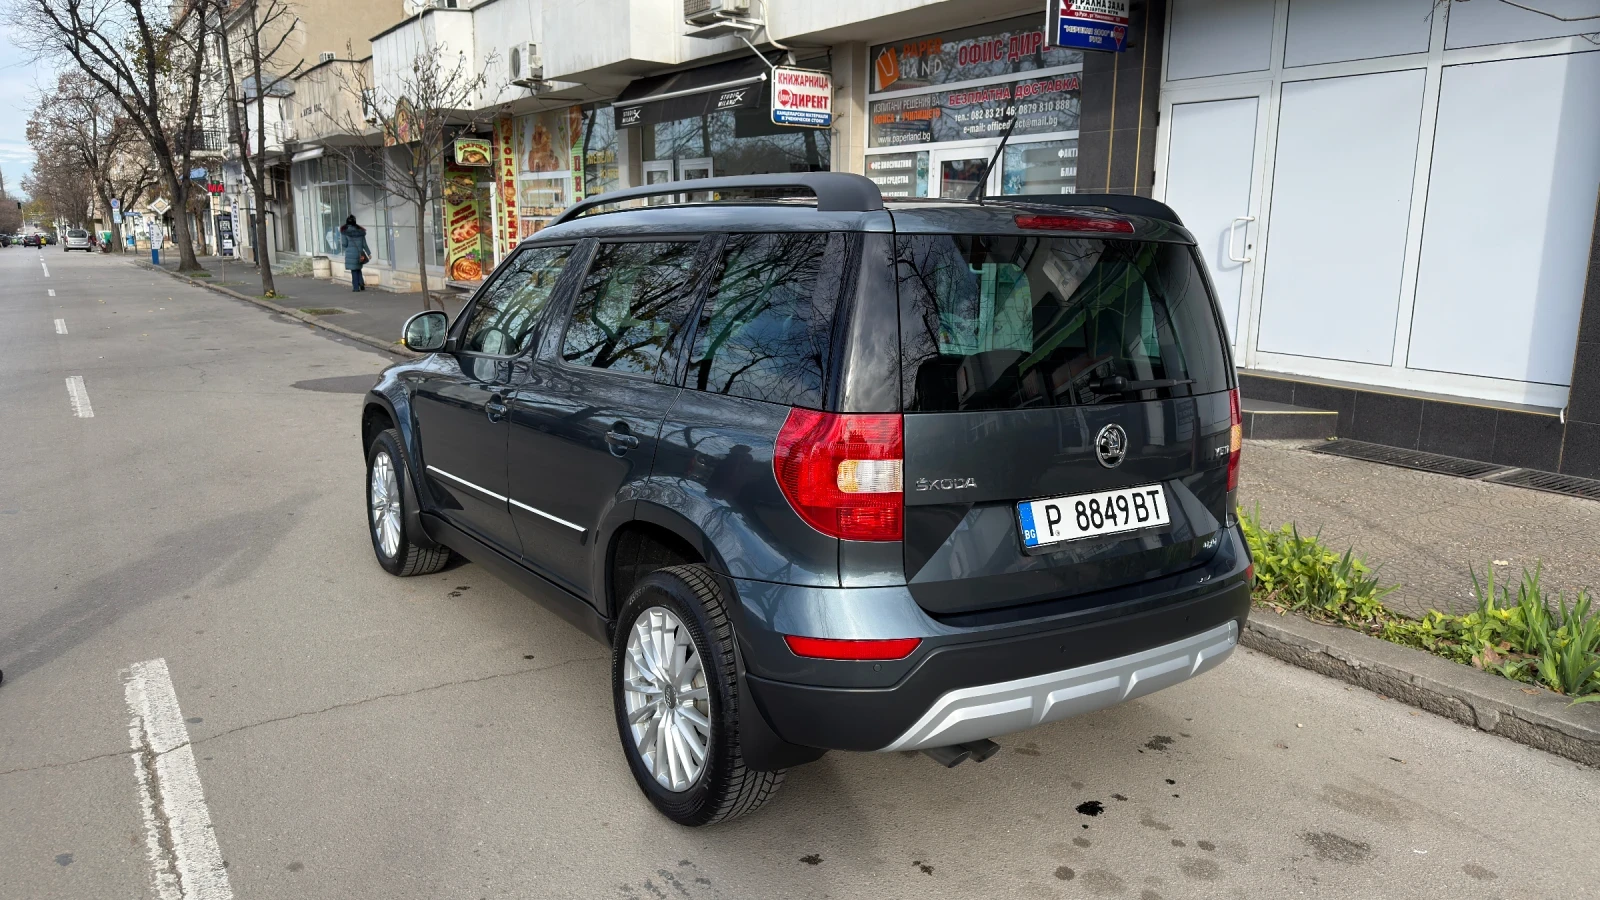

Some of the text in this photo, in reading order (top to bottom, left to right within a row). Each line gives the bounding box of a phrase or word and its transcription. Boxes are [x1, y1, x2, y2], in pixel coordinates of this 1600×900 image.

[1107, 1, 1125, 12] ЗАЛА
[903, 38, 942, 59] PAPER
[958, 31, 1055, 67] ОФИС ДИРЕ
[902, 59, 942, 79] LAND
[777, 72, 829, 91] КНИЖАРНИЦА
[720, 91, 739, 101] STUDIO
[948, 77, 1080, 106] БЕЗПЛАТНА ДОСТАВКА
[717, 99, 737, 108] MILANO
[790, 93, 829, 109] ДИРЕКТ
[903, 97, 931, 110] РЕШЕНИЯ
[931, 94, 941, 107] ЗА
[873, 113, 895, 124] ОФИСА
[901, 107, 942, 122] УЧИЛИЩЕТО
[954, 112, 970, 122] тел.:
[970, 110, 983, 121] 082
[985, 108, 994, 119] 83
[995, 107, 1005, 118] 21
[1018, 103, 1037, 115] 0879
[1039, 101, 1053, 112] 810
[1055, 99, 1070, 110] 888
[963, 116, 1058, 134] e-mail: officedect@mail.bg
[877, 131, 931, 144] www.paperland.bg
[1057, 147, 1078, 158] ФАКТ
[915, 476, 978, 492] ŠKODA
[1044, 489, 1161, 537] P 8849 BT
[1024, 529, 1036, 540] BG
